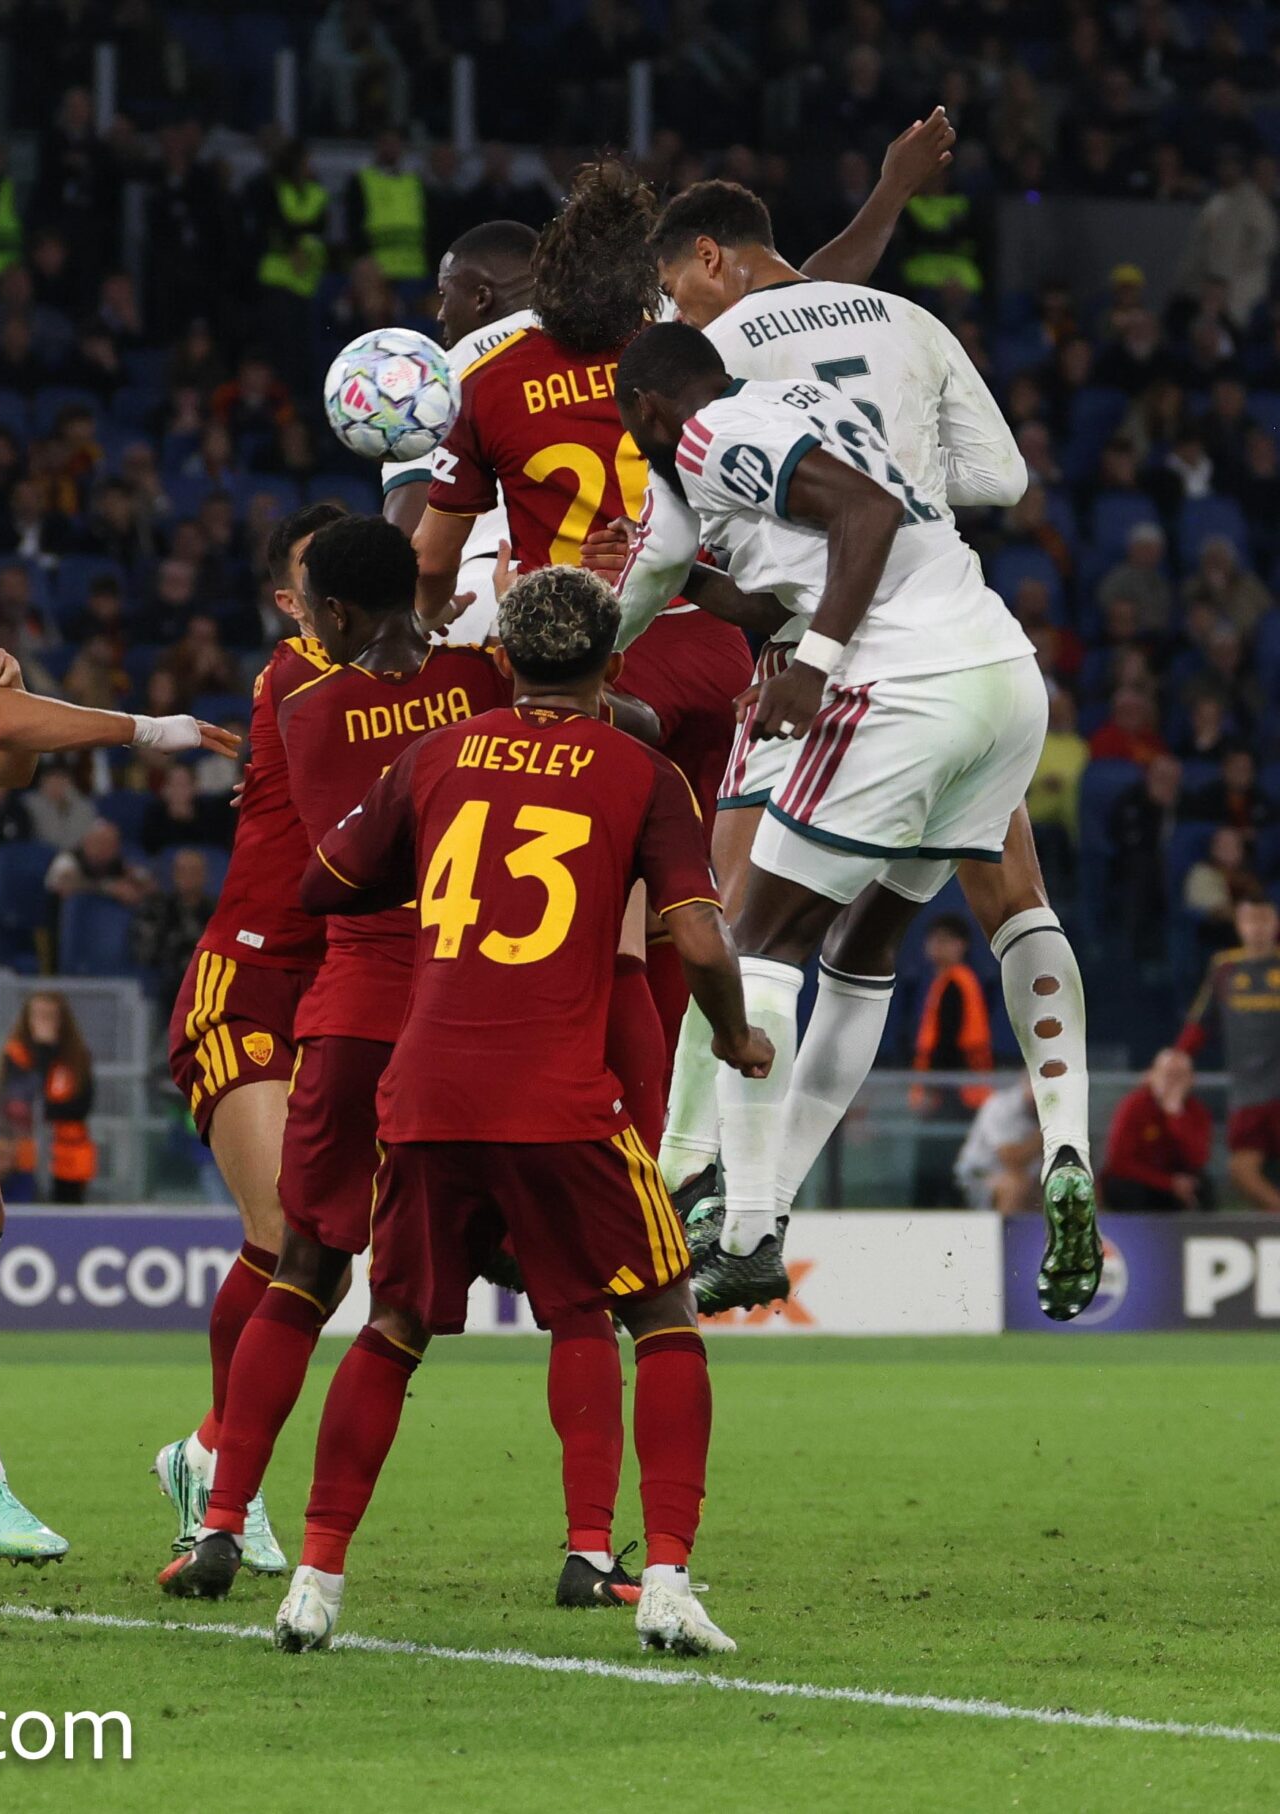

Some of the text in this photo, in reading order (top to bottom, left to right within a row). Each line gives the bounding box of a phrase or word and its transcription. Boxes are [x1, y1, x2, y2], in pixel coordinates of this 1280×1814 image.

[739, 297, 891, 348] BELLINGHAM
[720, 443, 773, 503] hp
[345, 687, 472, 743] NDICKA
[456, 734, 595, 778] WESLEY
[421, 800, 592, 965] 43
